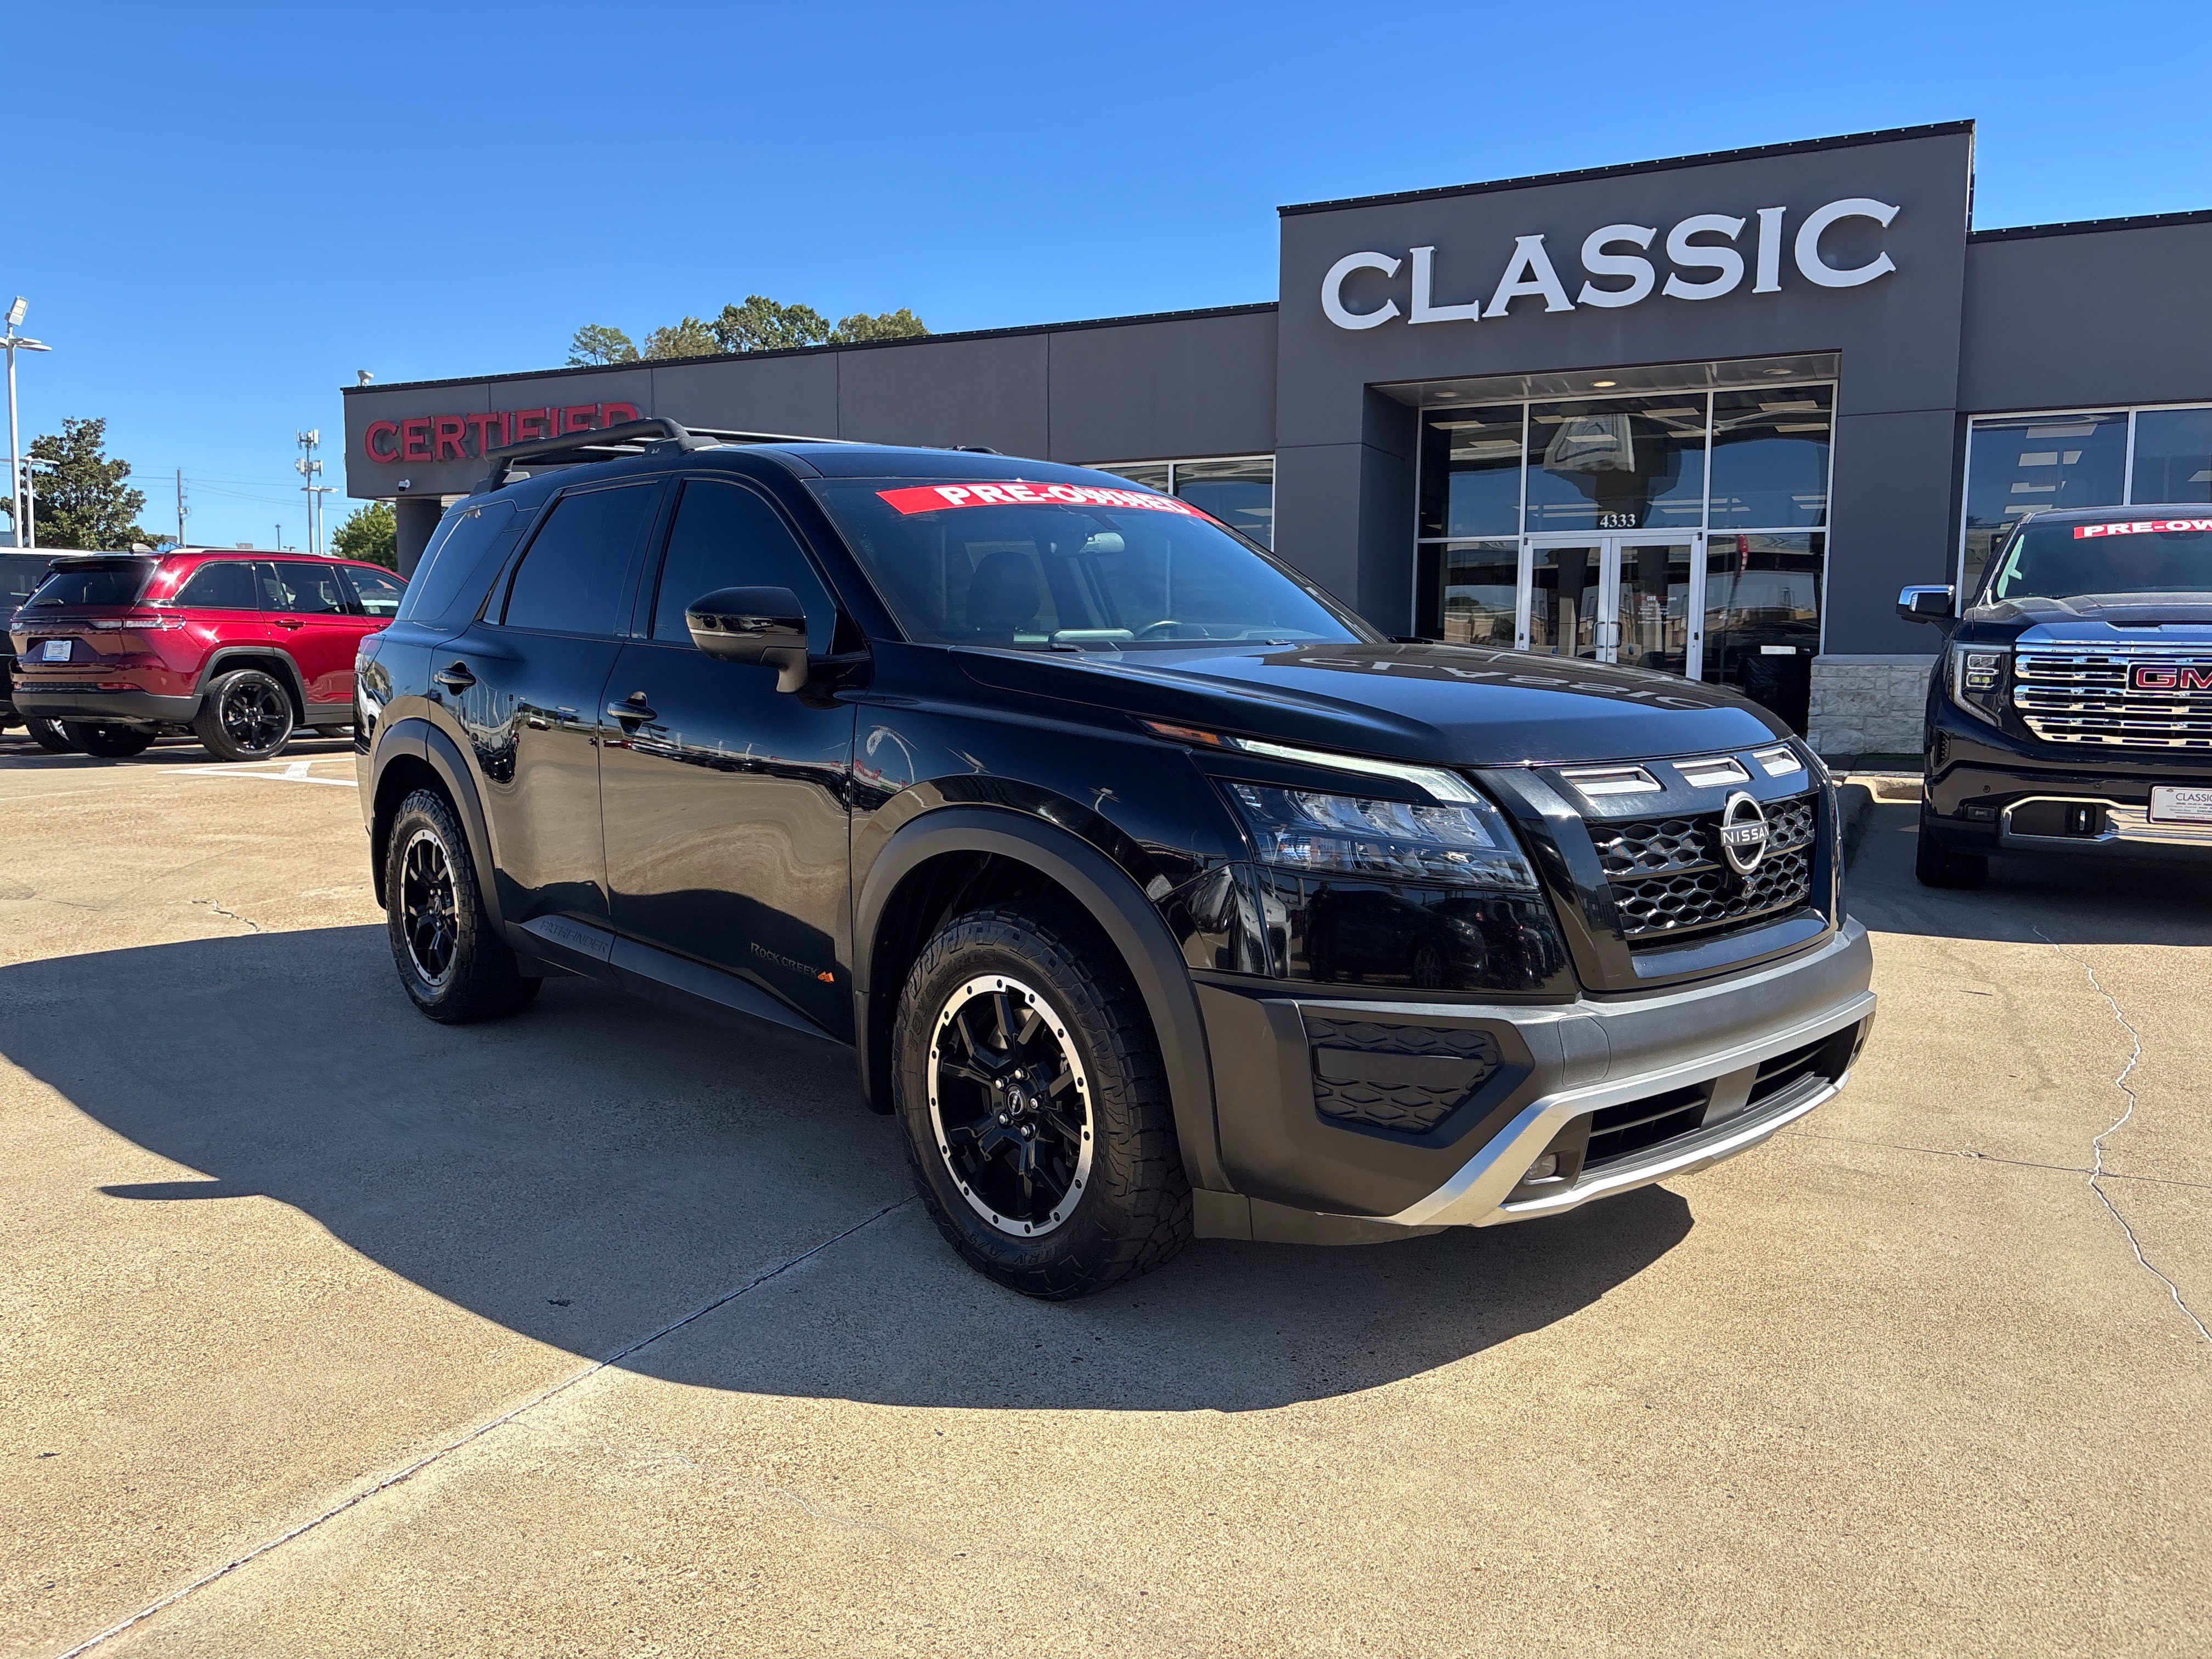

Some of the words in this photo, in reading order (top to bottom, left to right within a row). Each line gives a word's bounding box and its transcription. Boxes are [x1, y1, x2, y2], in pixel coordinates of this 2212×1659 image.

[1321, 197, 1901, 331] CLASSIC
[933, 484, 1191, 515] PRE-OWNED
[1599, 513, 1636, 529] 4333
[1723, 825, 1769, 844] NISSAN
[751, 941, 781, 964] ROCK
[781, 956, 820, 978] CREEK
[907, 980, 937, 1052] TOYO
